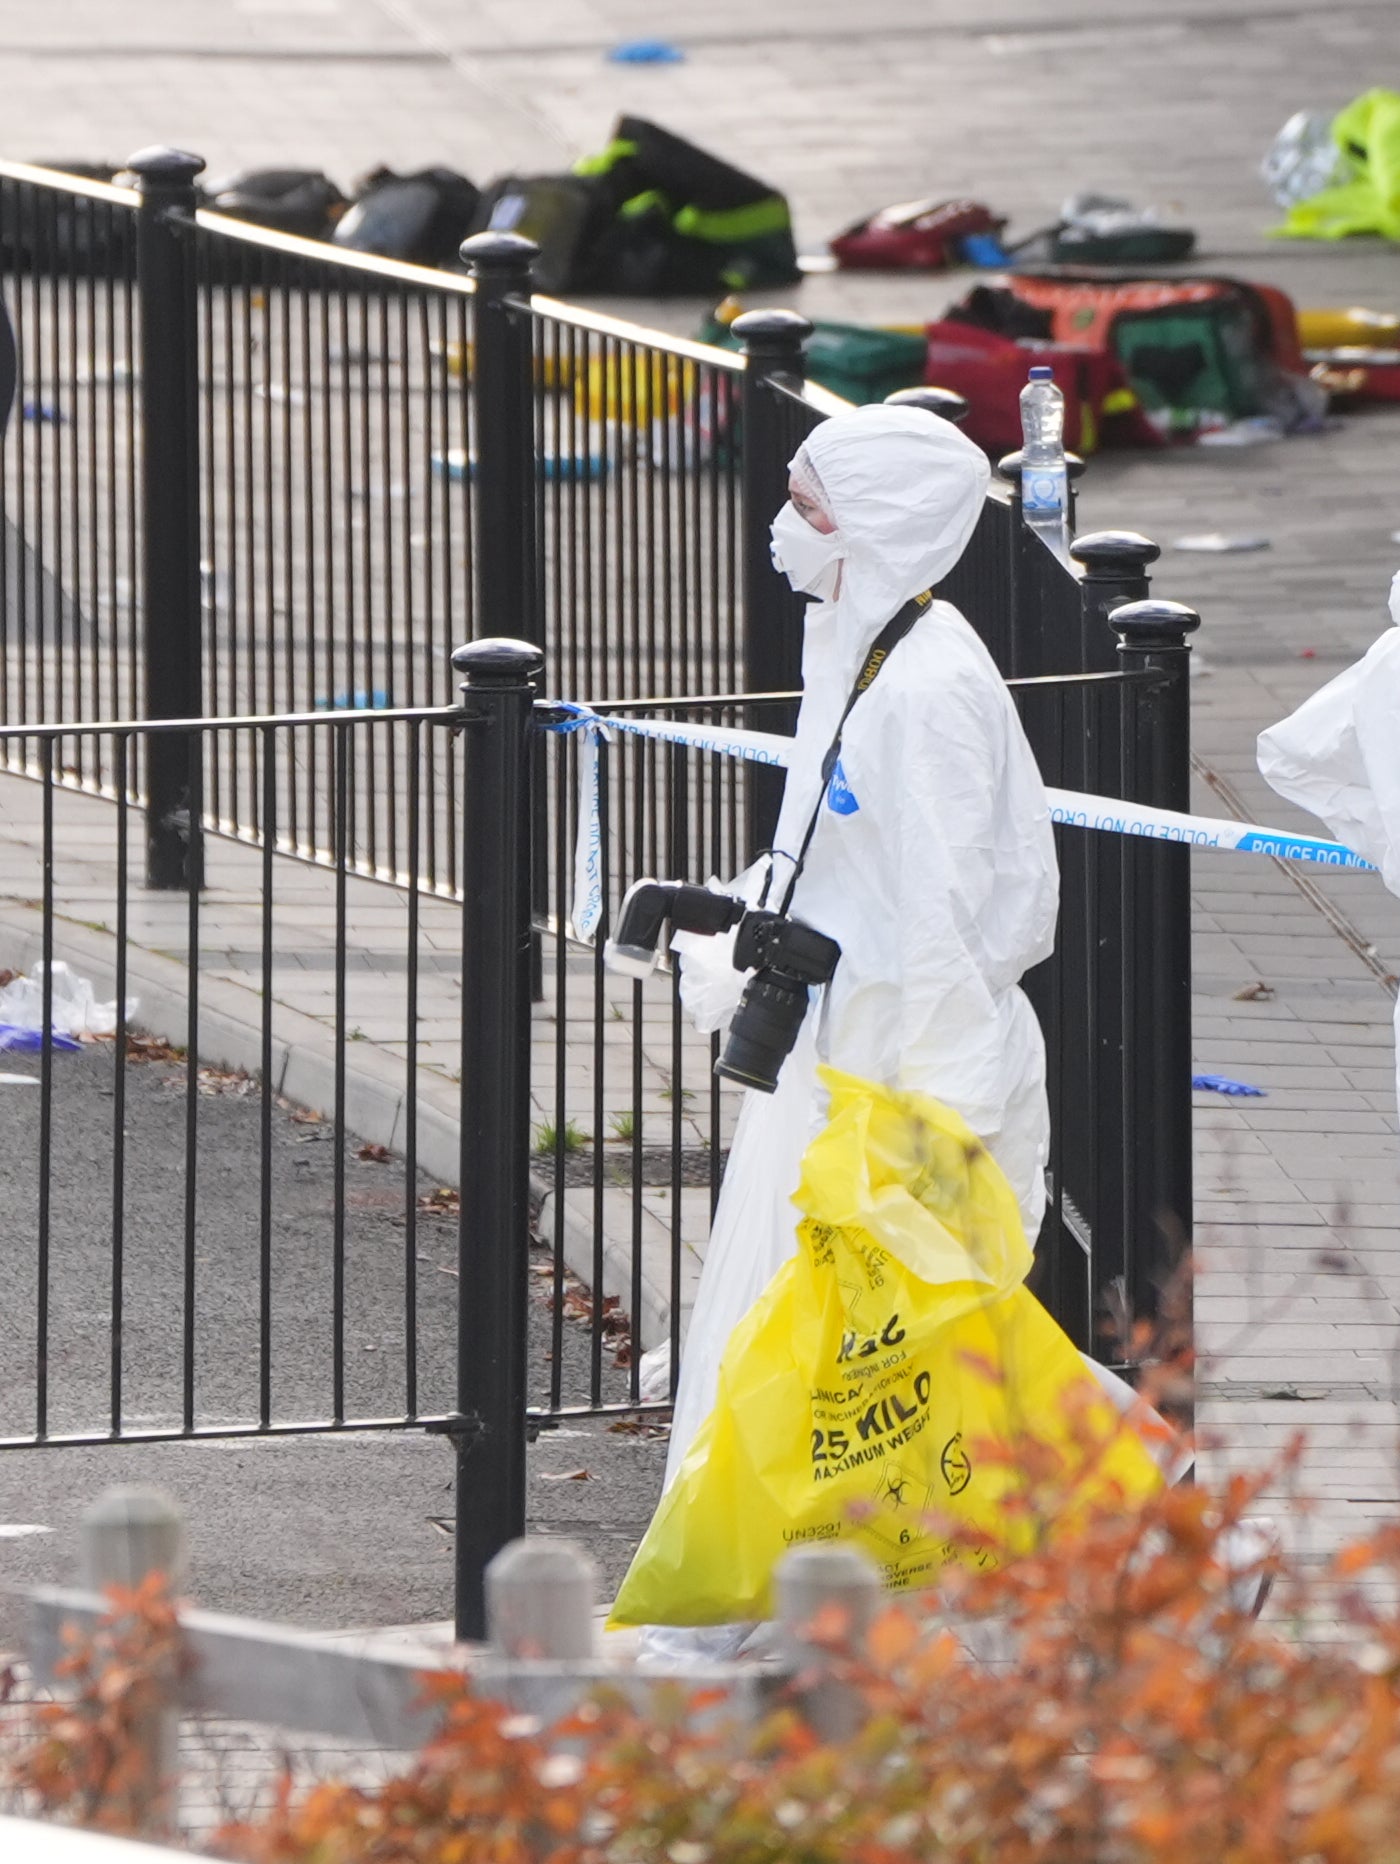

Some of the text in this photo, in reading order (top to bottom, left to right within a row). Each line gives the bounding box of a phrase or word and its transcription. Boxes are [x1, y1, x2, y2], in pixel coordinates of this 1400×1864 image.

[1049, 807, 1087, 828] CRO
[1130, 820, 1155, 838] DO
[1159, 824, 1220, 847] POLICE
[1252, 838, 1313, 862] POLICE
[1316, 849, 1341, 865] DO
[811, 1371, 931, 1461] 25 KILO
[814, 1443, 886, 1482] MAXIMUM
[782, 1520, 841, 1542] UN3291
[900, 1528, 911, 1545] 6
